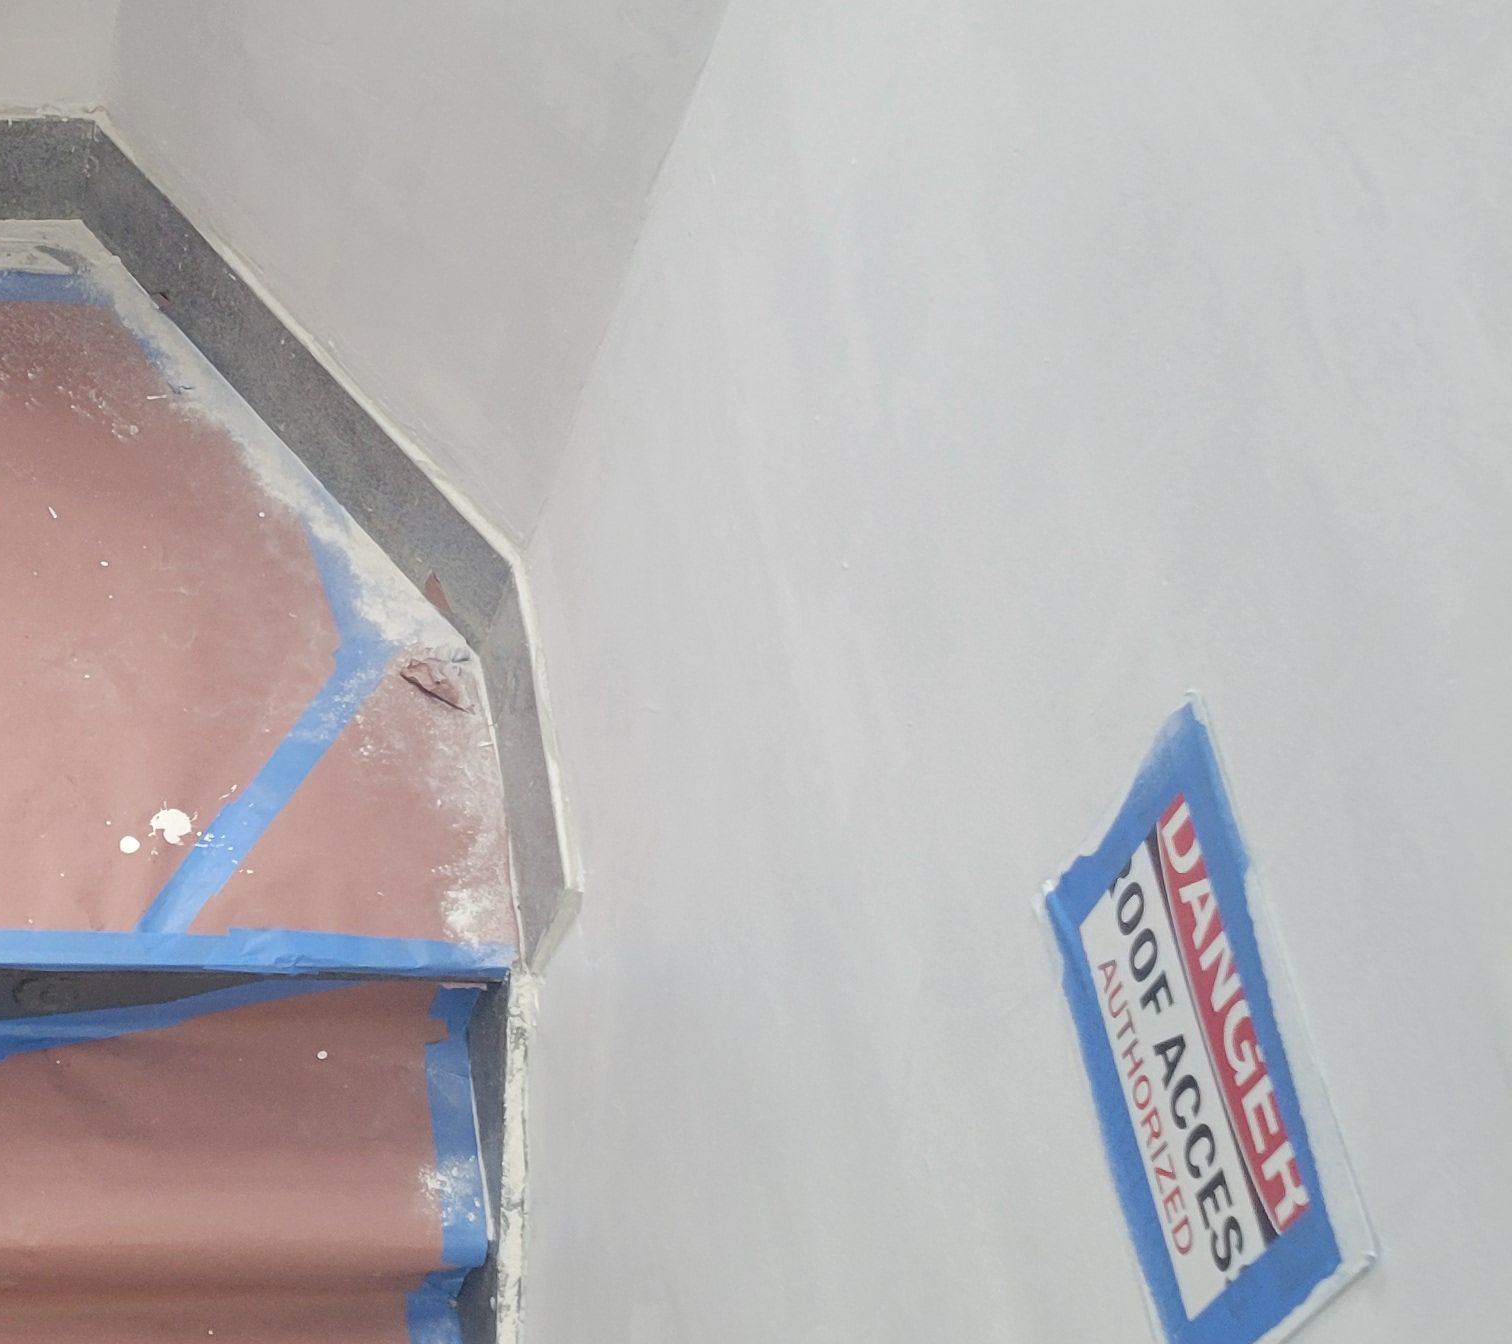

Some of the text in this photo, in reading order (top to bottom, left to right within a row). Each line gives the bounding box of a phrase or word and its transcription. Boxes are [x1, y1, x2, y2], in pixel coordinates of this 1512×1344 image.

[1097, 959, 1193, 1255] AUTHORIZED
[1161, 801, 1311, 1223] DANGER
[1153, 1034, 1249, 1287] ACCES
